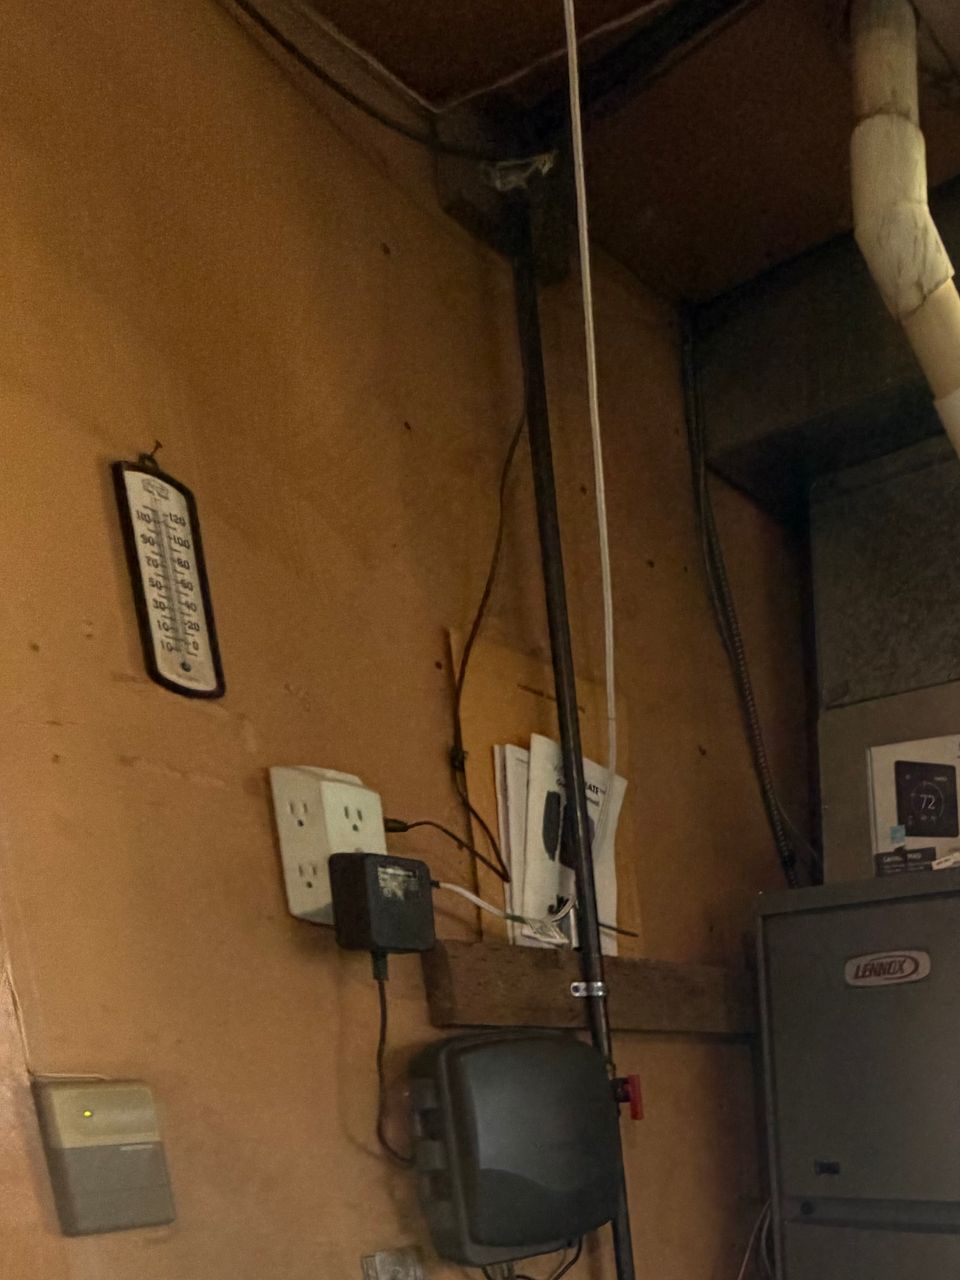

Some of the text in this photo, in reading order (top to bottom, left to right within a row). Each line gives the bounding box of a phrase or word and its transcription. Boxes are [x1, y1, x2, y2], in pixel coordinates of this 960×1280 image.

[169, 512, 186, 527] 120
[173, 535, 190, 550] 100
[920, 794, 936, 810] 72
[854, 959, 907, 980] LENNOX
